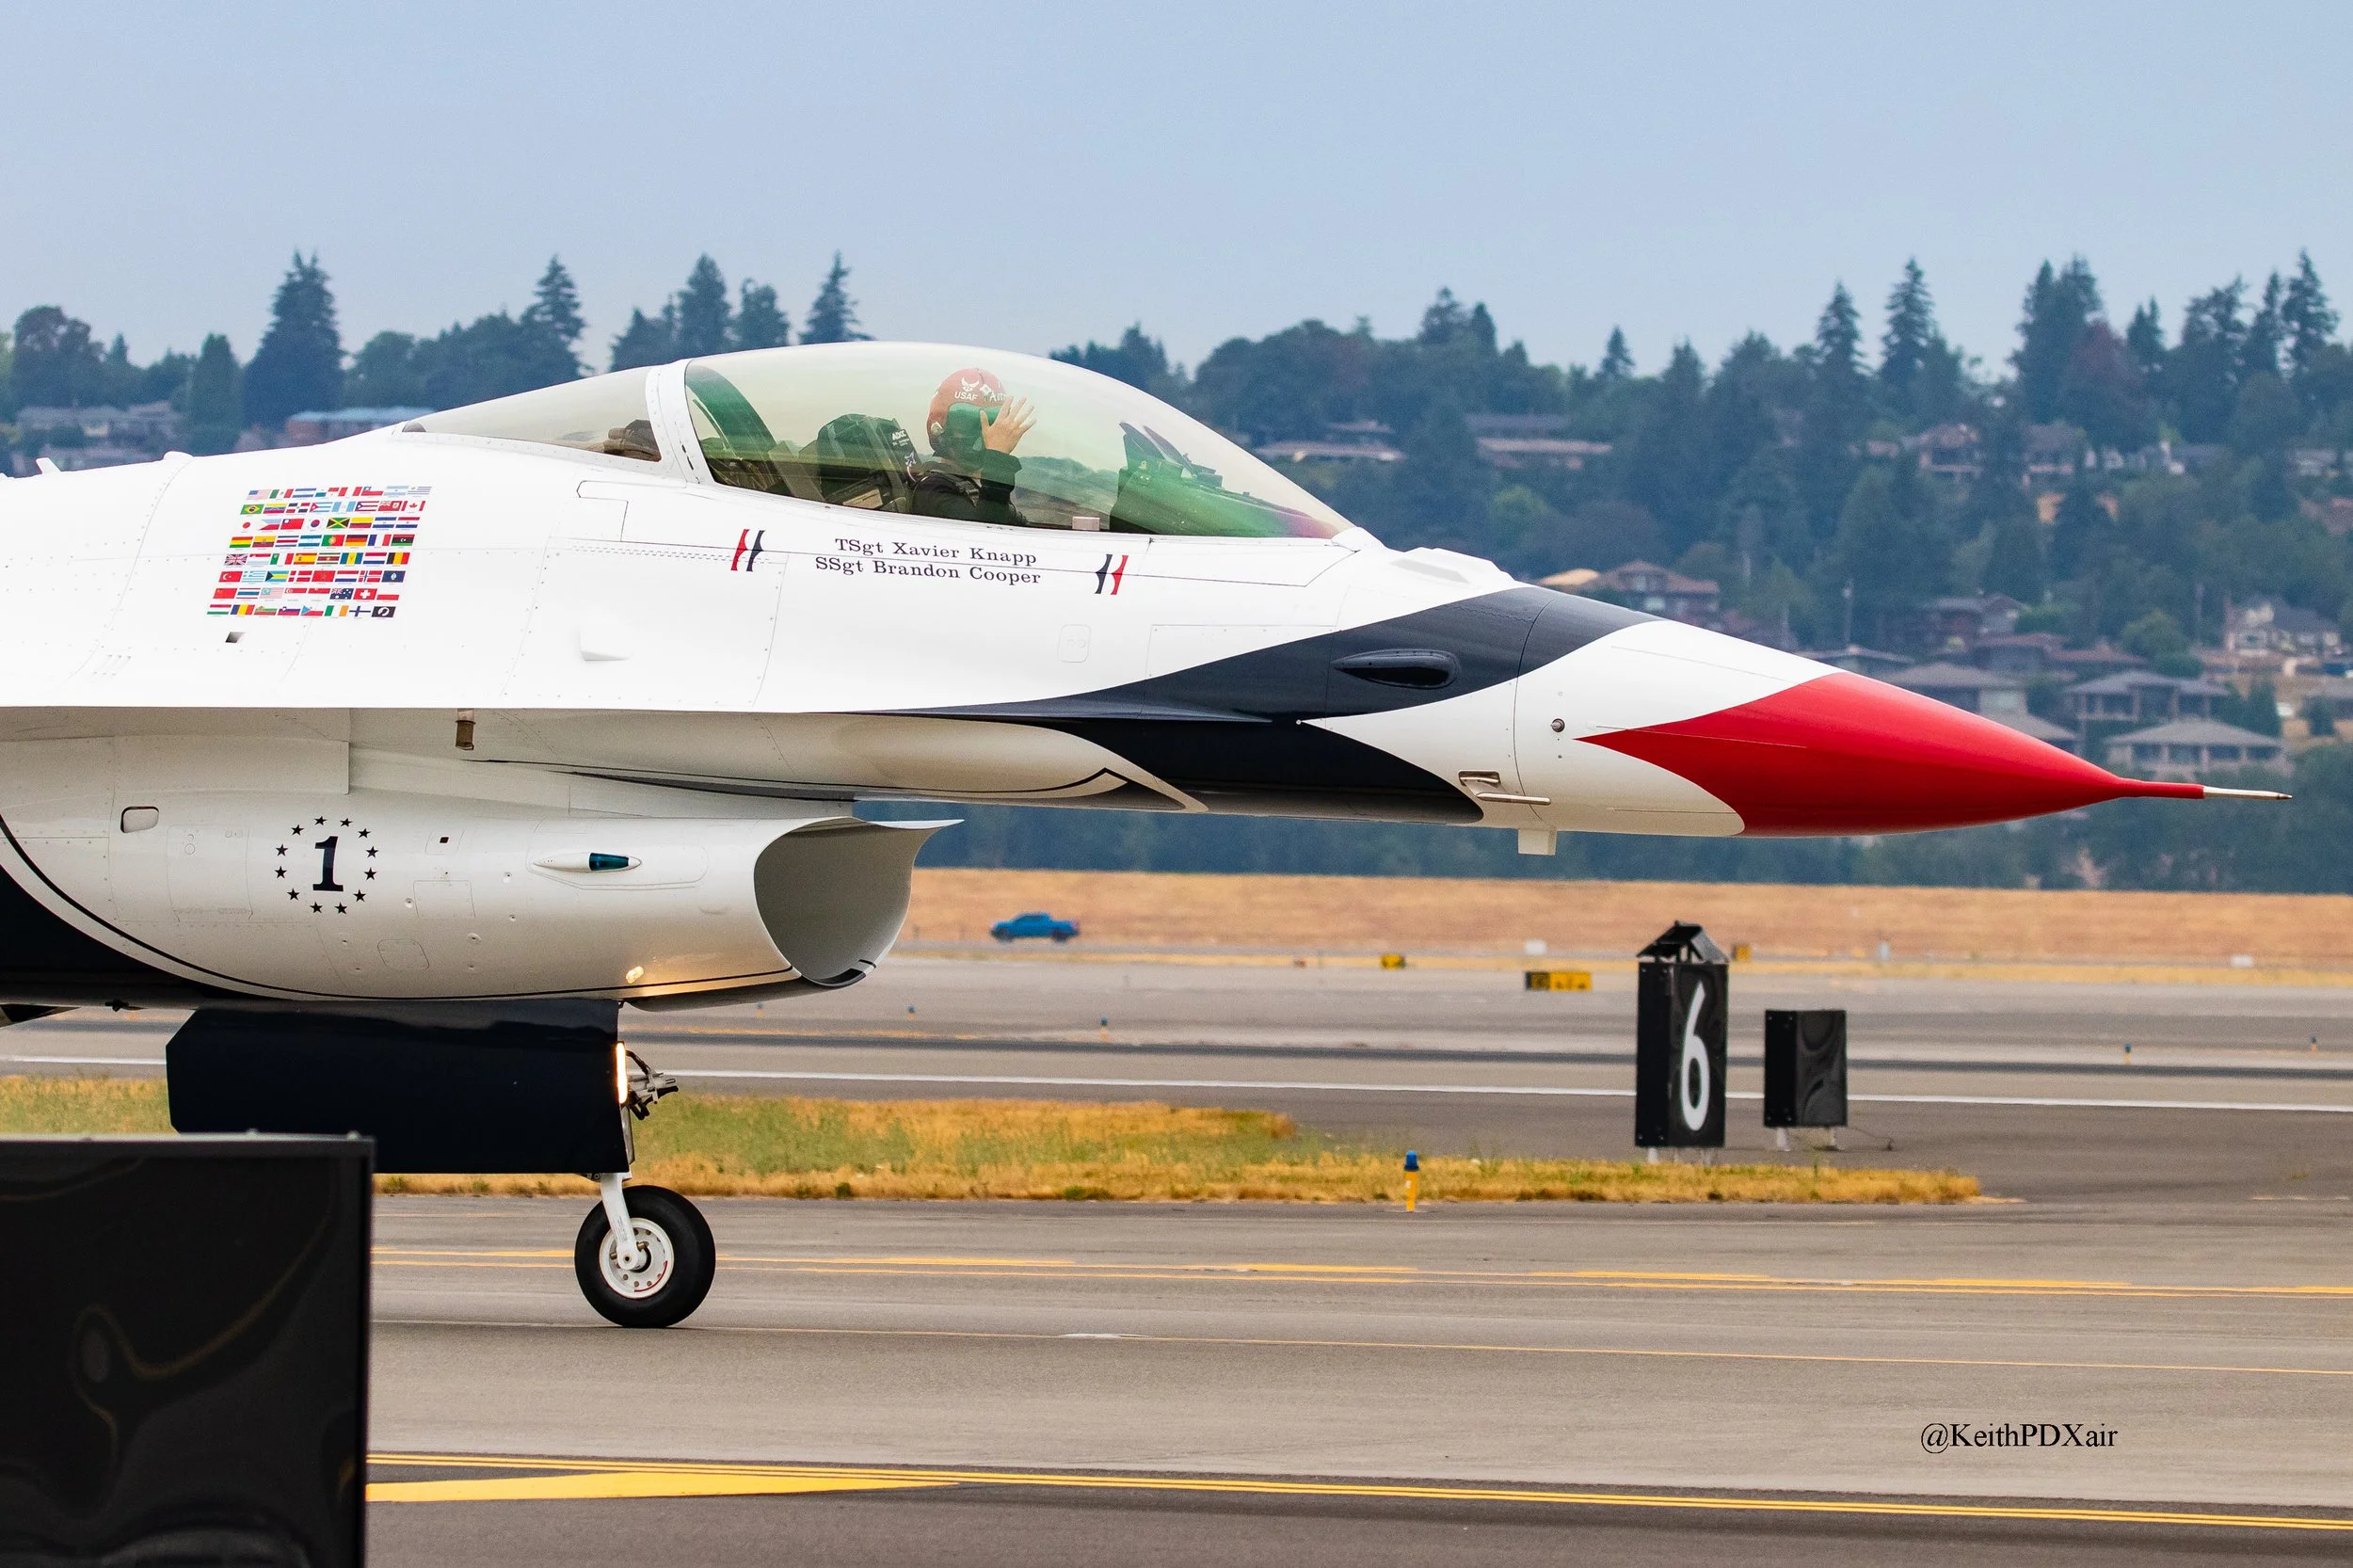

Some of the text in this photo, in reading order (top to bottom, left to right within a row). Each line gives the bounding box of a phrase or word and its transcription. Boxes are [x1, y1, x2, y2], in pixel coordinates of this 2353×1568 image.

[954, 392, 978, 402] USAF
[835, 538, 1036, 567] TSgt Xavier Knapp
[815, 556, 1041, 585] SSgt Brandon Cooper
[312, 836, 344, 892] 1
[1681, 981, 1710, 1131] 6
